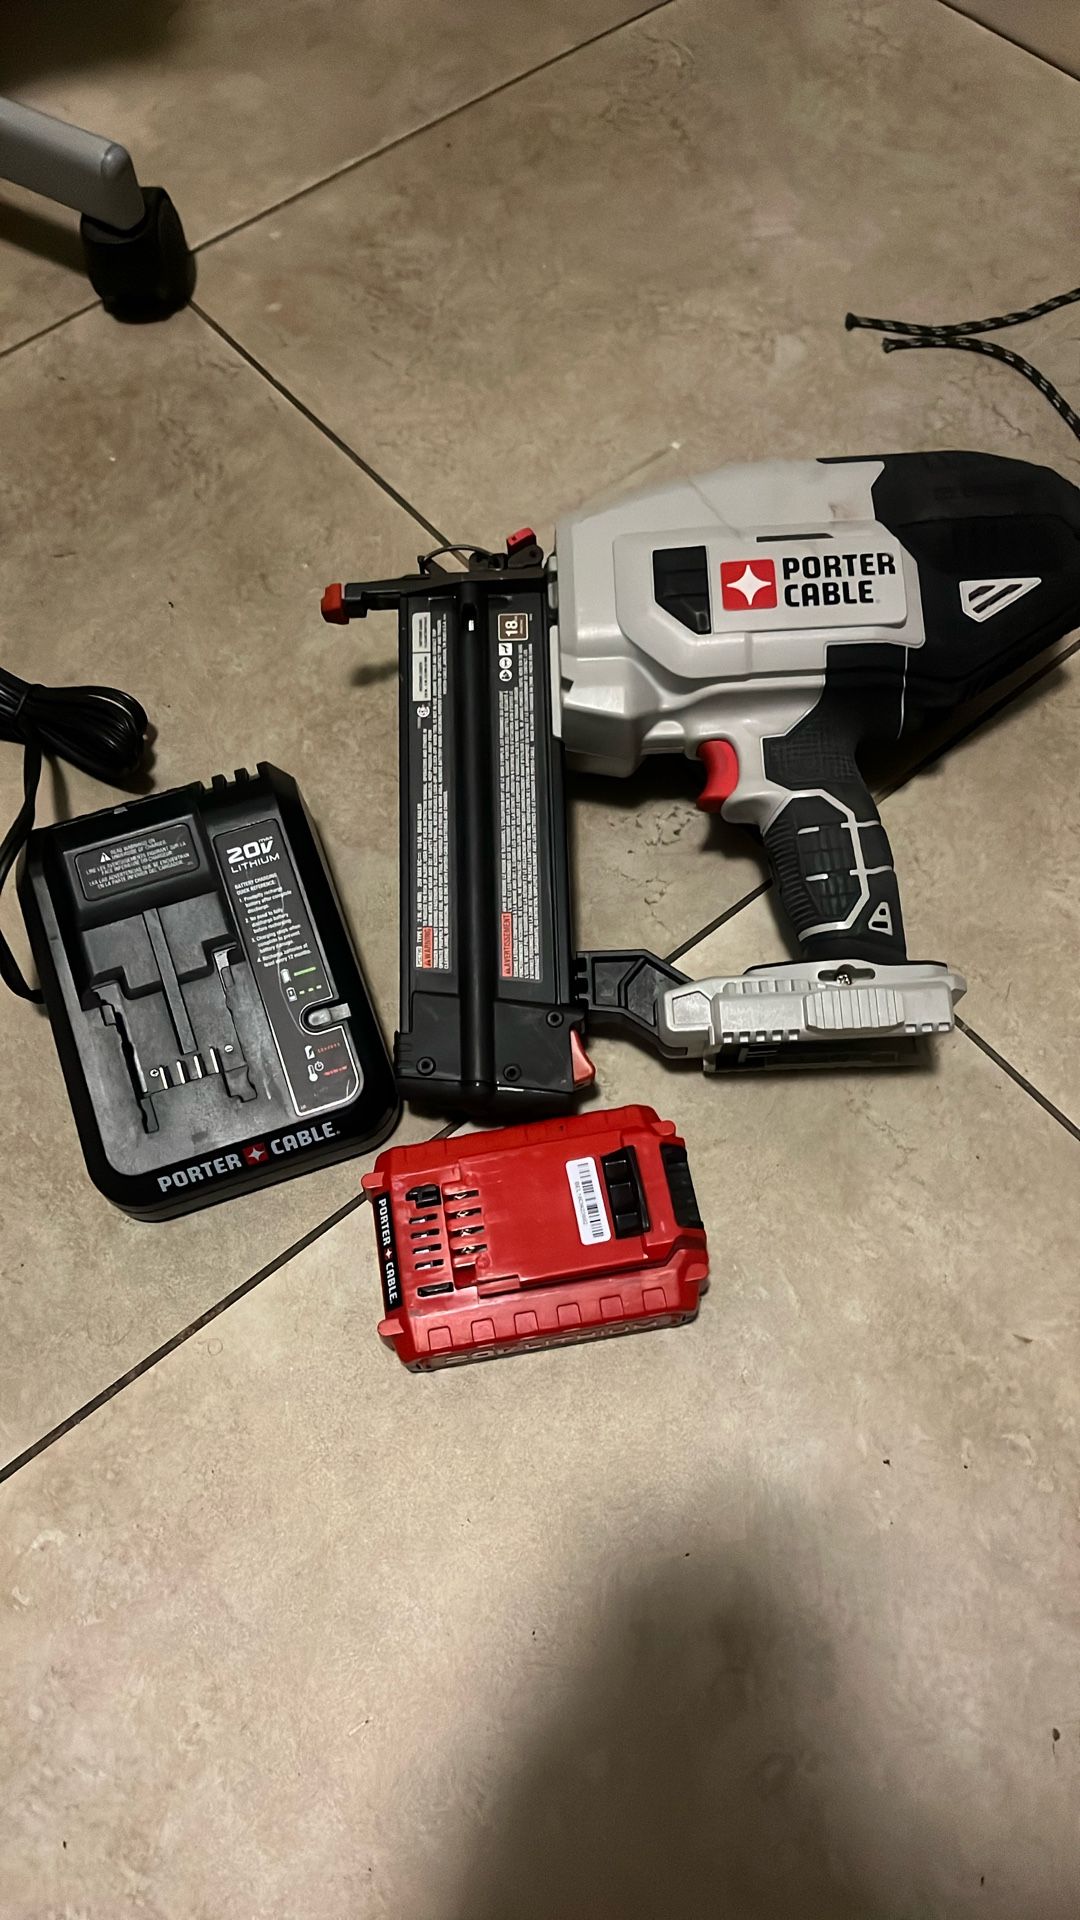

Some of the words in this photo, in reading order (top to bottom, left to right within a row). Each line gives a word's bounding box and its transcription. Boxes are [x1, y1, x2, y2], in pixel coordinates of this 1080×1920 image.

[782, 552, 896, 580] PORTER
[784, 580, 874, 607] CABLE
[505, 620, 518, 637] 18
[227, 840, 273, 864] 20V
[231, 853, 280, 873] LITHIUM
[235, 880, 253, 889] BATTERY
[502, 914, 510, 966] AVERTISSEMENT
[156, 1154, 242, 1192] PORTER
[270, 1122, 336, 1155] CABLE
[378, 1198, 391, 1246] PORTER
[386, 1262, 398, 1302] CABLE
[524, 1321, 657, 1350] LITHIUM
